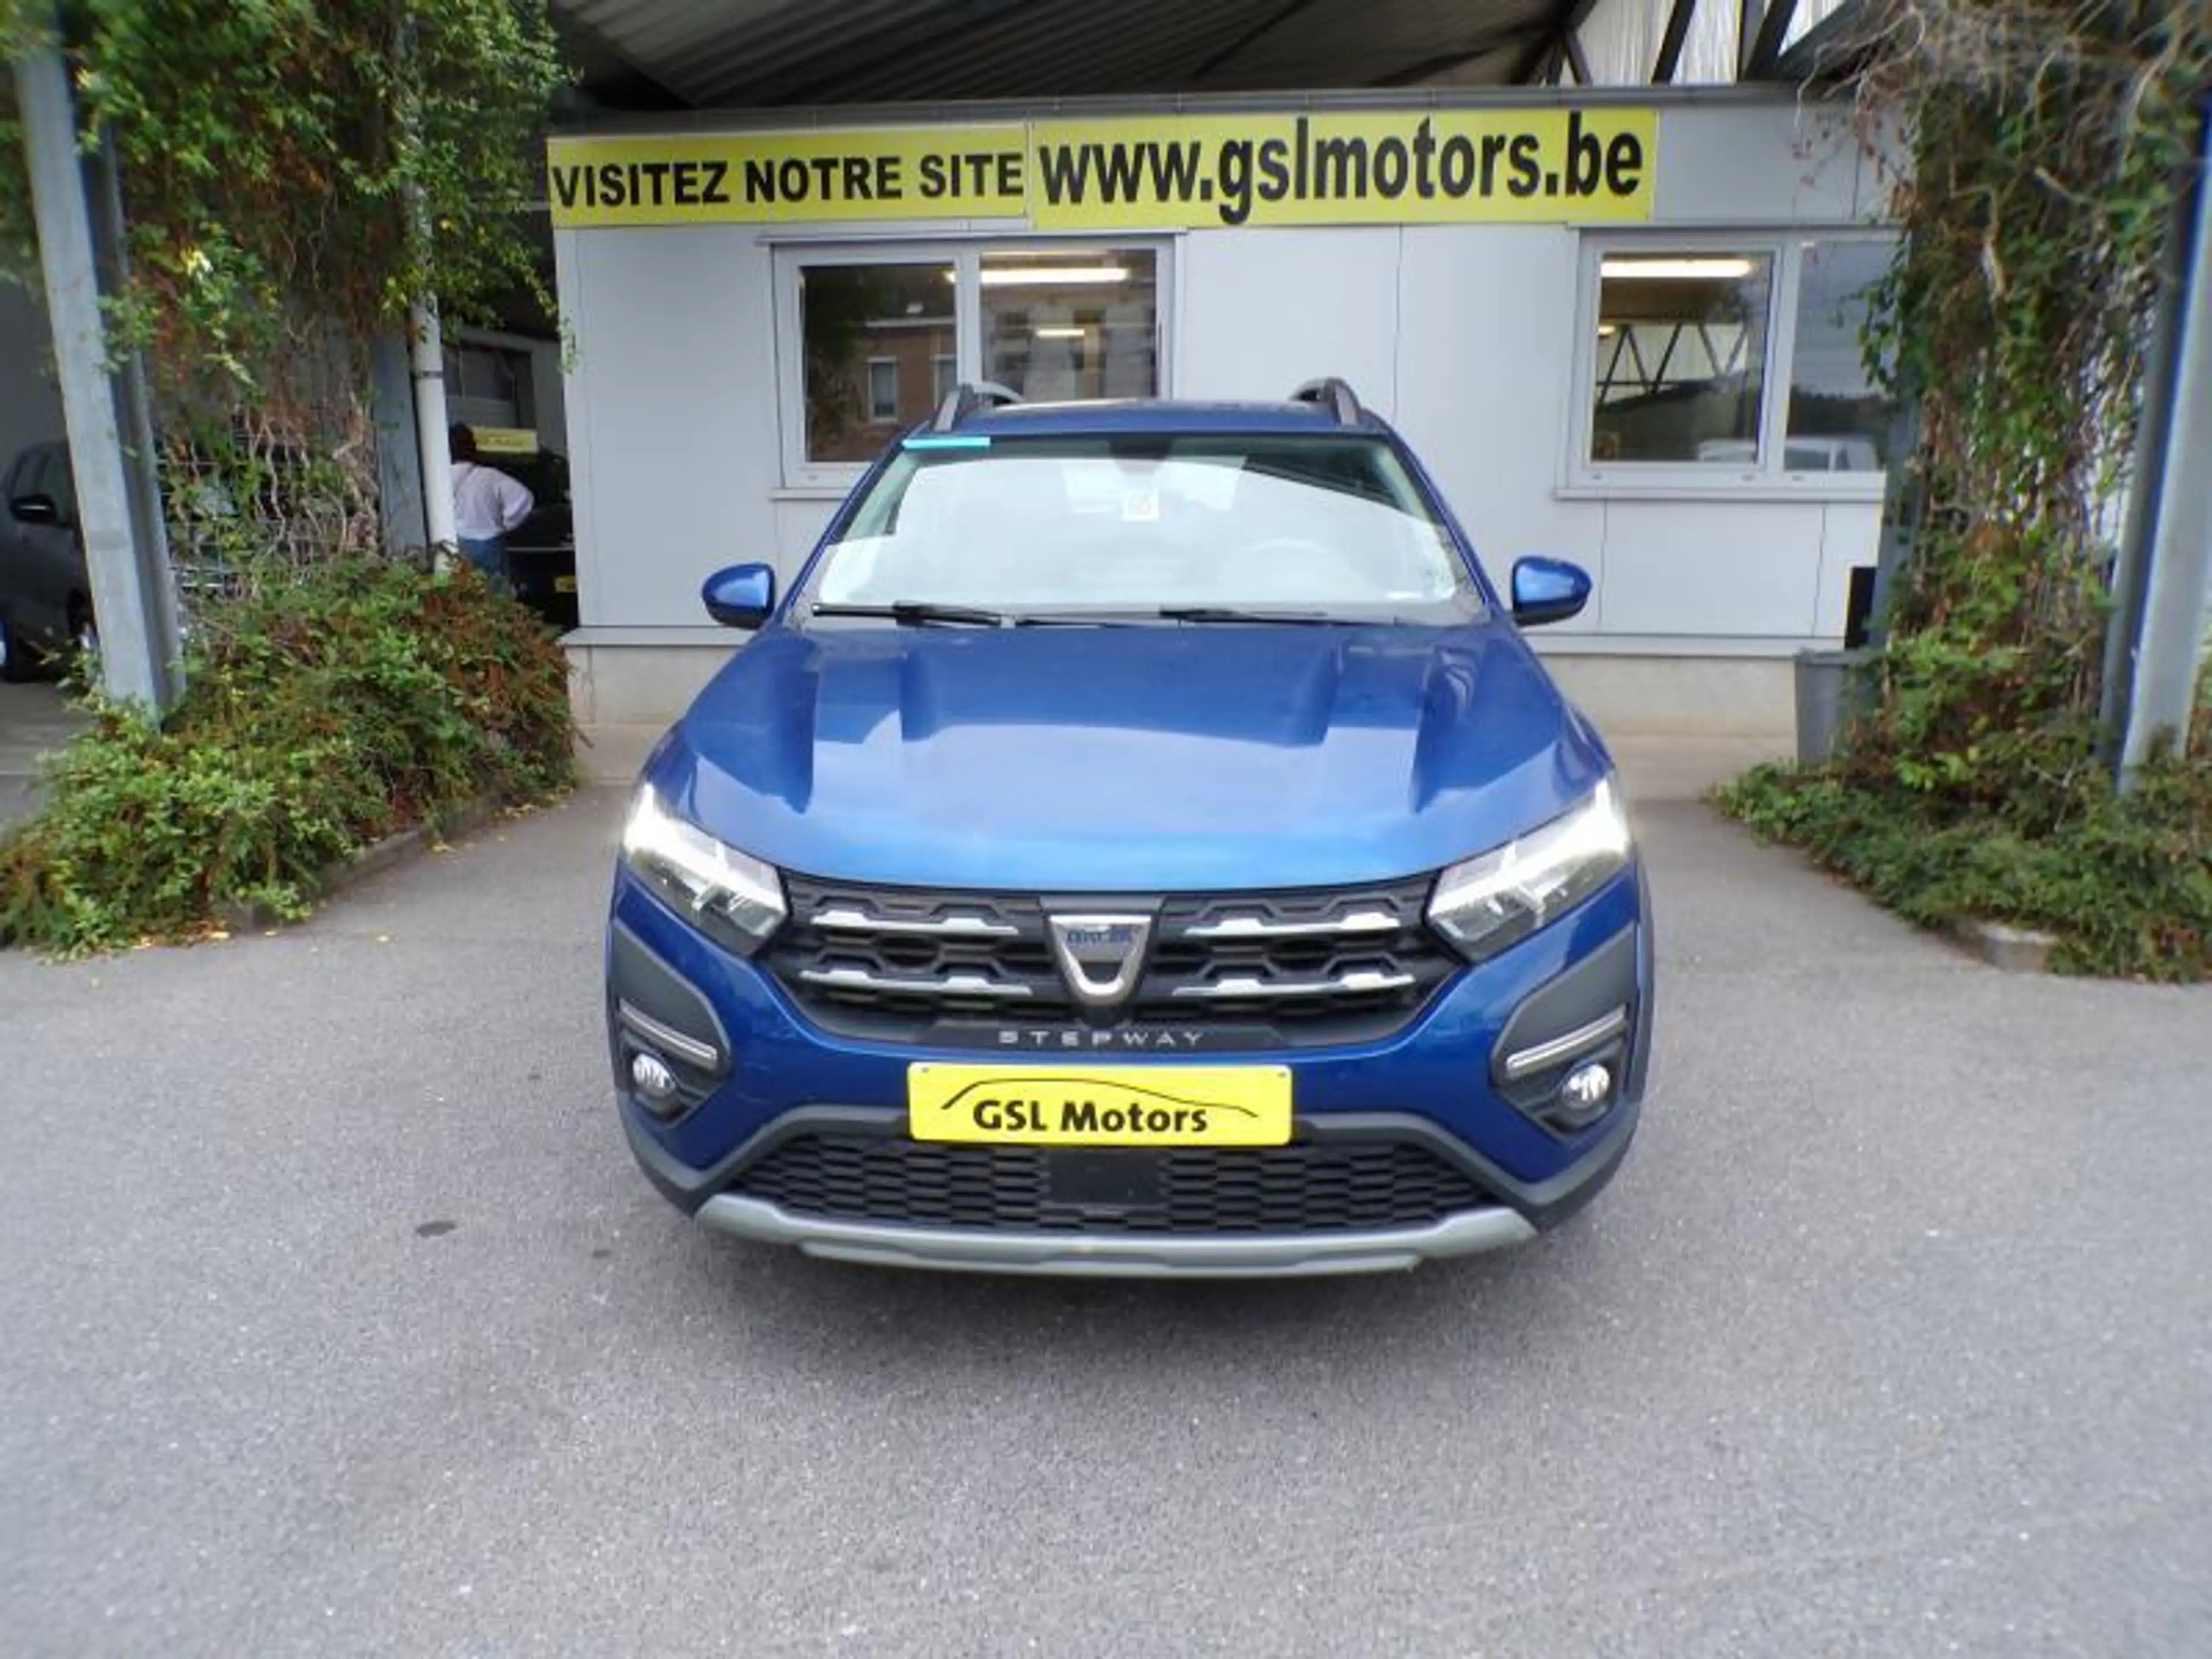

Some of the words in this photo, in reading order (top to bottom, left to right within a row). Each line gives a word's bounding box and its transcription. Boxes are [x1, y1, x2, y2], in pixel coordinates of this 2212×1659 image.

[551, 161, 730, 208] VISITEZ
[744, 155, 903, 203] NOTRE
[919, 151, 1024, 198] SITE
[1039, 111, 1643, 225] www.gslmotors.be
[998, 1030, 1202, 1047] STEPWAY
[973, 1100, 1048, 1132] GSL
[1060, 1101, 1207, 1132] Motors
